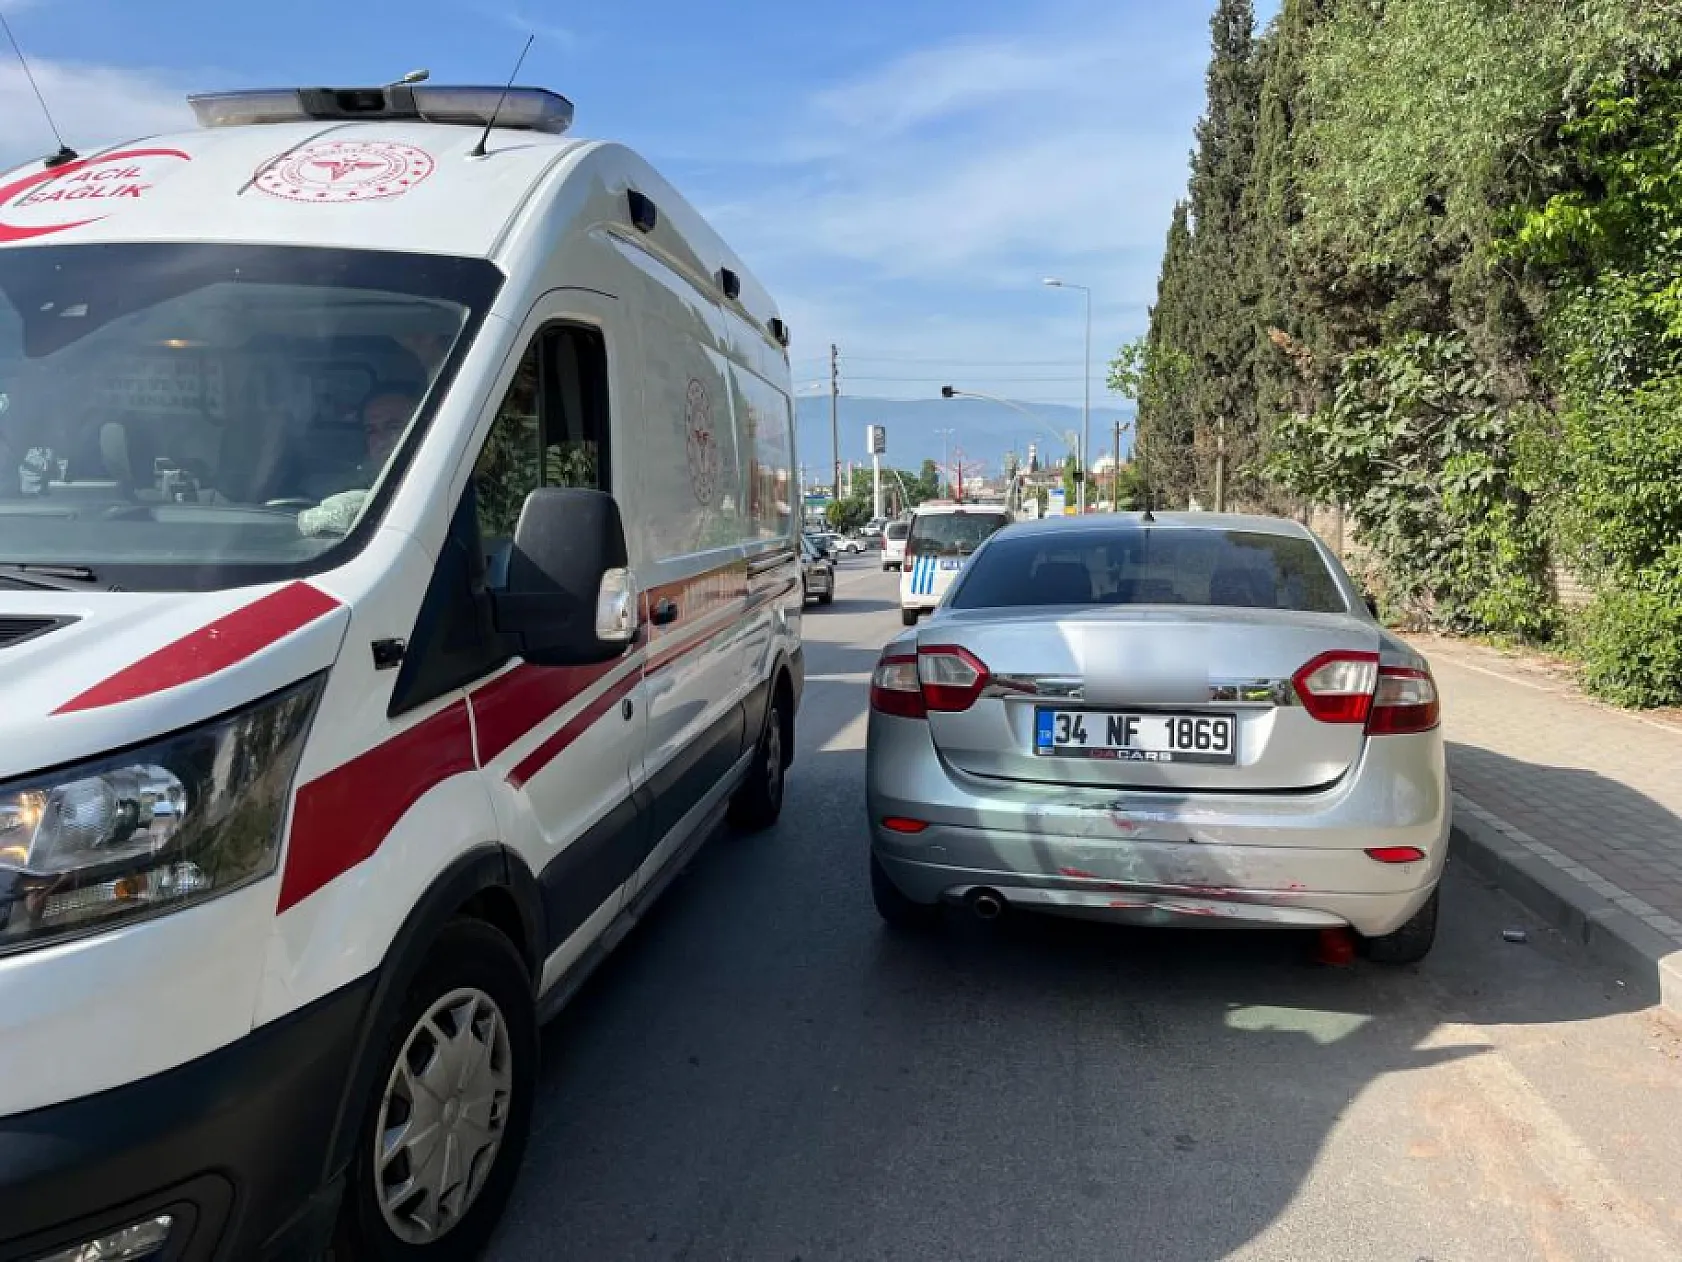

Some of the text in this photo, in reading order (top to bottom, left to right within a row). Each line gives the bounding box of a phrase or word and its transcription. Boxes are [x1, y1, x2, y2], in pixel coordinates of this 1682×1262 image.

[1055, 714, 1229, 751] 34 NF 1869
